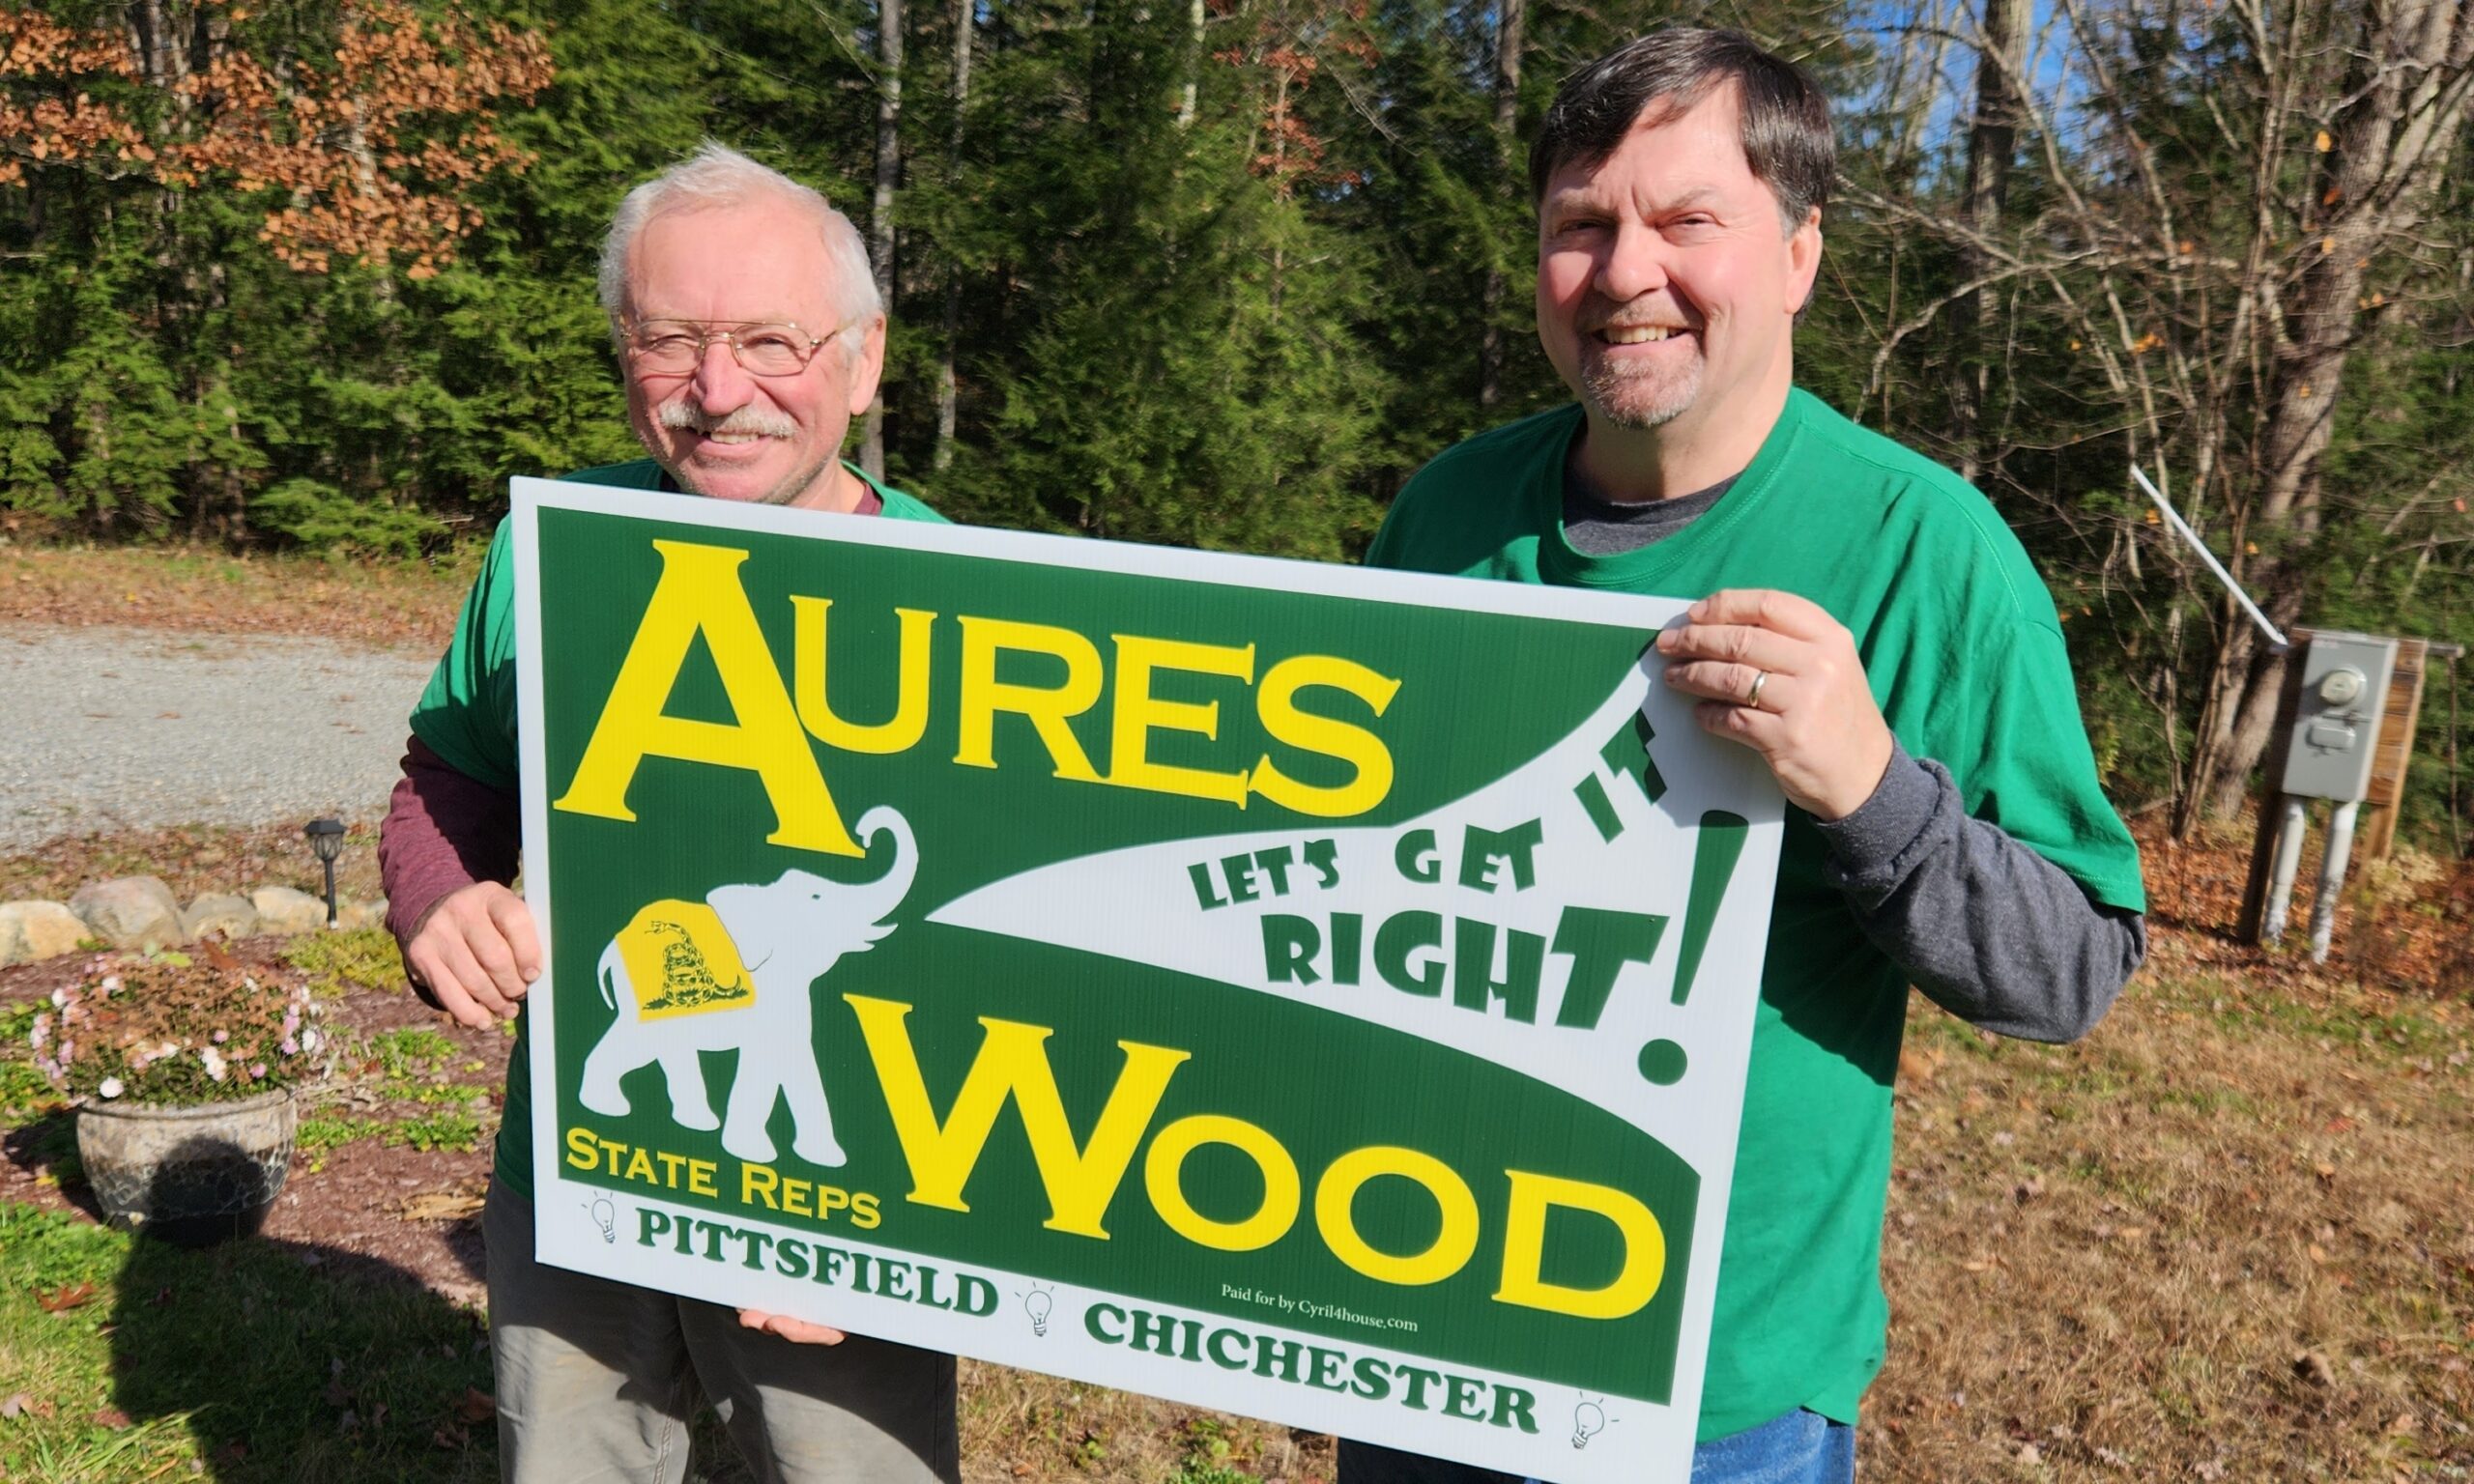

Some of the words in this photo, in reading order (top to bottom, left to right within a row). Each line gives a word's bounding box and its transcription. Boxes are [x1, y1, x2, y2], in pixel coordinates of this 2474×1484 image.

[553, 537, 1401, 858] AURES
[1188, 839, 1340, 911] LET'S
[1394, 817, 1543, 894] GET
[1573, 708, 1668, 844] IT
[1259, 810, 1749, 1087] RIGHT!
[565, 1127, 718, 1197] STATE
[740, 1162, 882, 1230] REPS
[843, 993, 1666, 1320] WOOD
[636, 1207, 999, 1318] PITTSFIELD
[1083, 1301, 1539, 1436] CHICHESTER
[1222, 1283, 1251, 1302] Paid
[1254, 1290, 1276, 1306] for
[1279, 1295, 1296, 1314] by
[1298, 1300, 1419, 1332] Cyril4house.com
